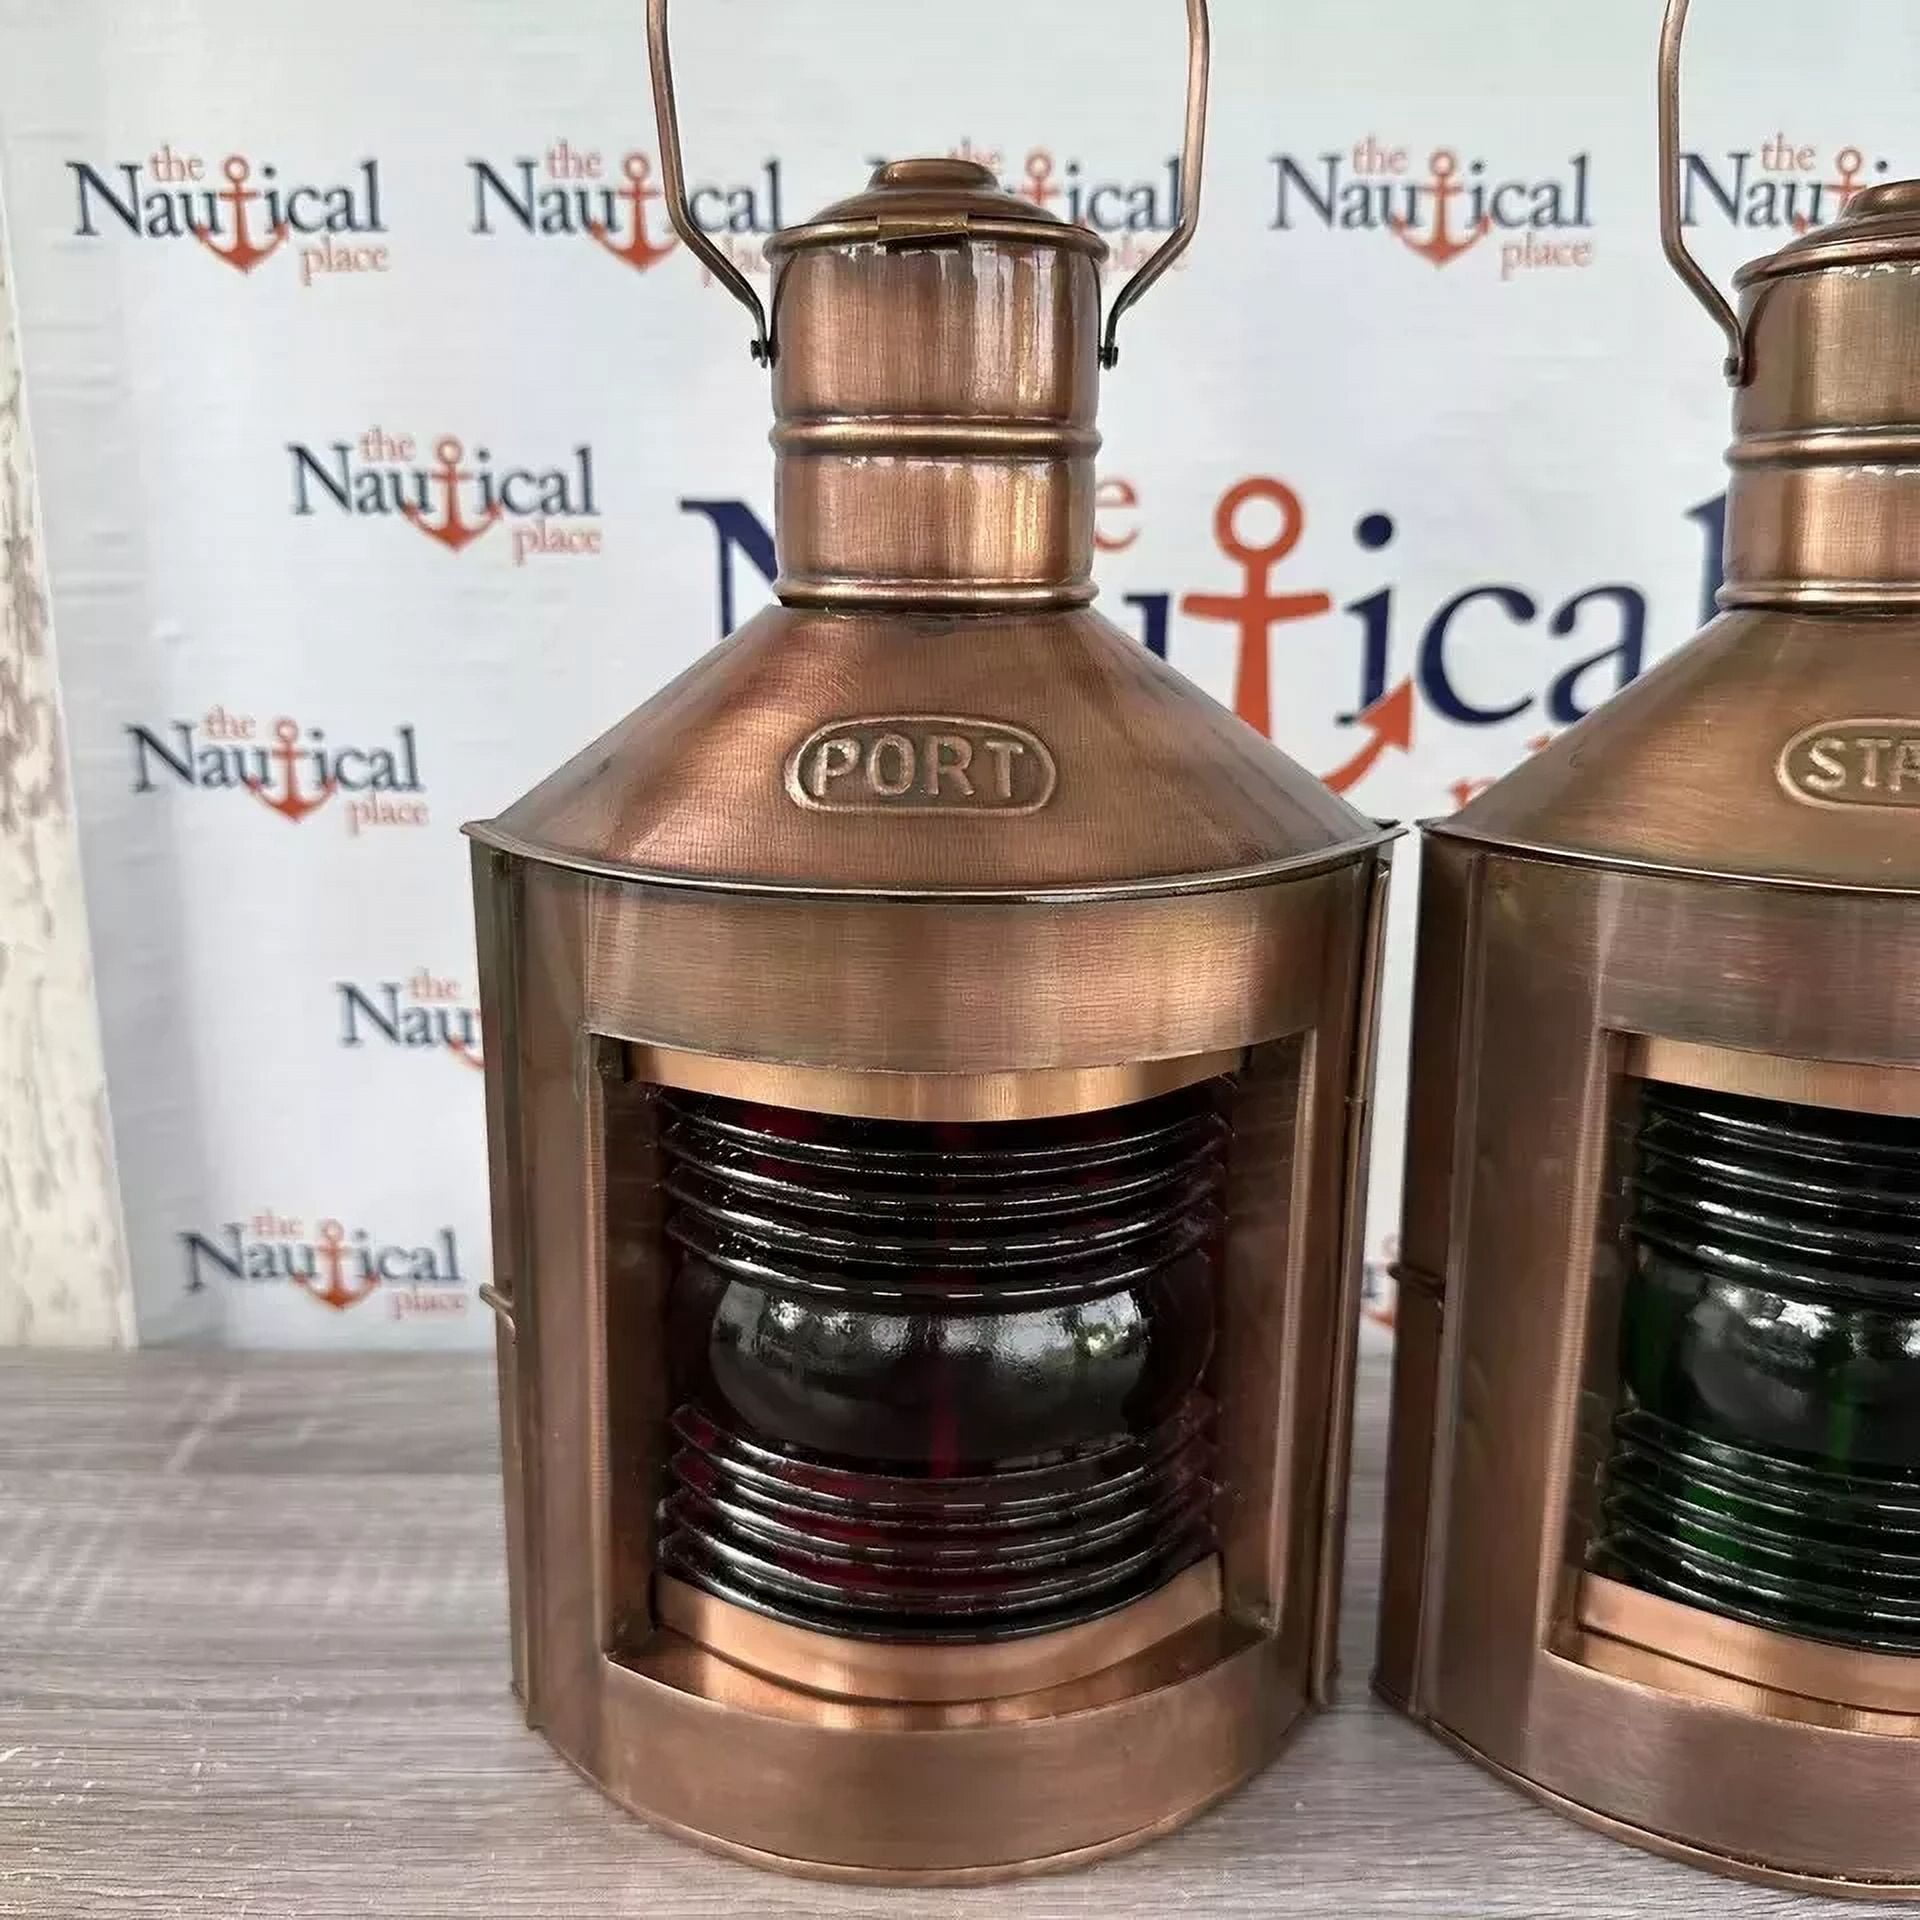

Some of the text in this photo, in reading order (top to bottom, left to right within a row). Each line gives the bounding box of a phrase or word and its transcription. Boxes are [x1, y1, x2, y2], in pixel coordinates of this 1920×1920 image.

[151, 144, 204, 182] the
[547, 138, 602, 178] the
[1352, 134, 1408, 174] the
[1762, 132, 1816, 171] the
[65, 155, 388, 275] Nautical
[466, 153, 783, 272] Nautcal
[1268, 147, 1594, 268] Nautical
[302, 236, 388, 286] place
[1501, 232, 1593, 280] place
[360, 426, 415, 462] the
[286, 434, 600, 552] Nautical
[512, 520, 601, 567] place
[205, 704, 255, 738] the
[125, 718, 423, 822] Nautical
[813, 733, 1024, 798] PORT
[346, 790, 427, 836] place
[406, 967, 460, 998] the
[178, 1214, 463, 1309] Nautical
